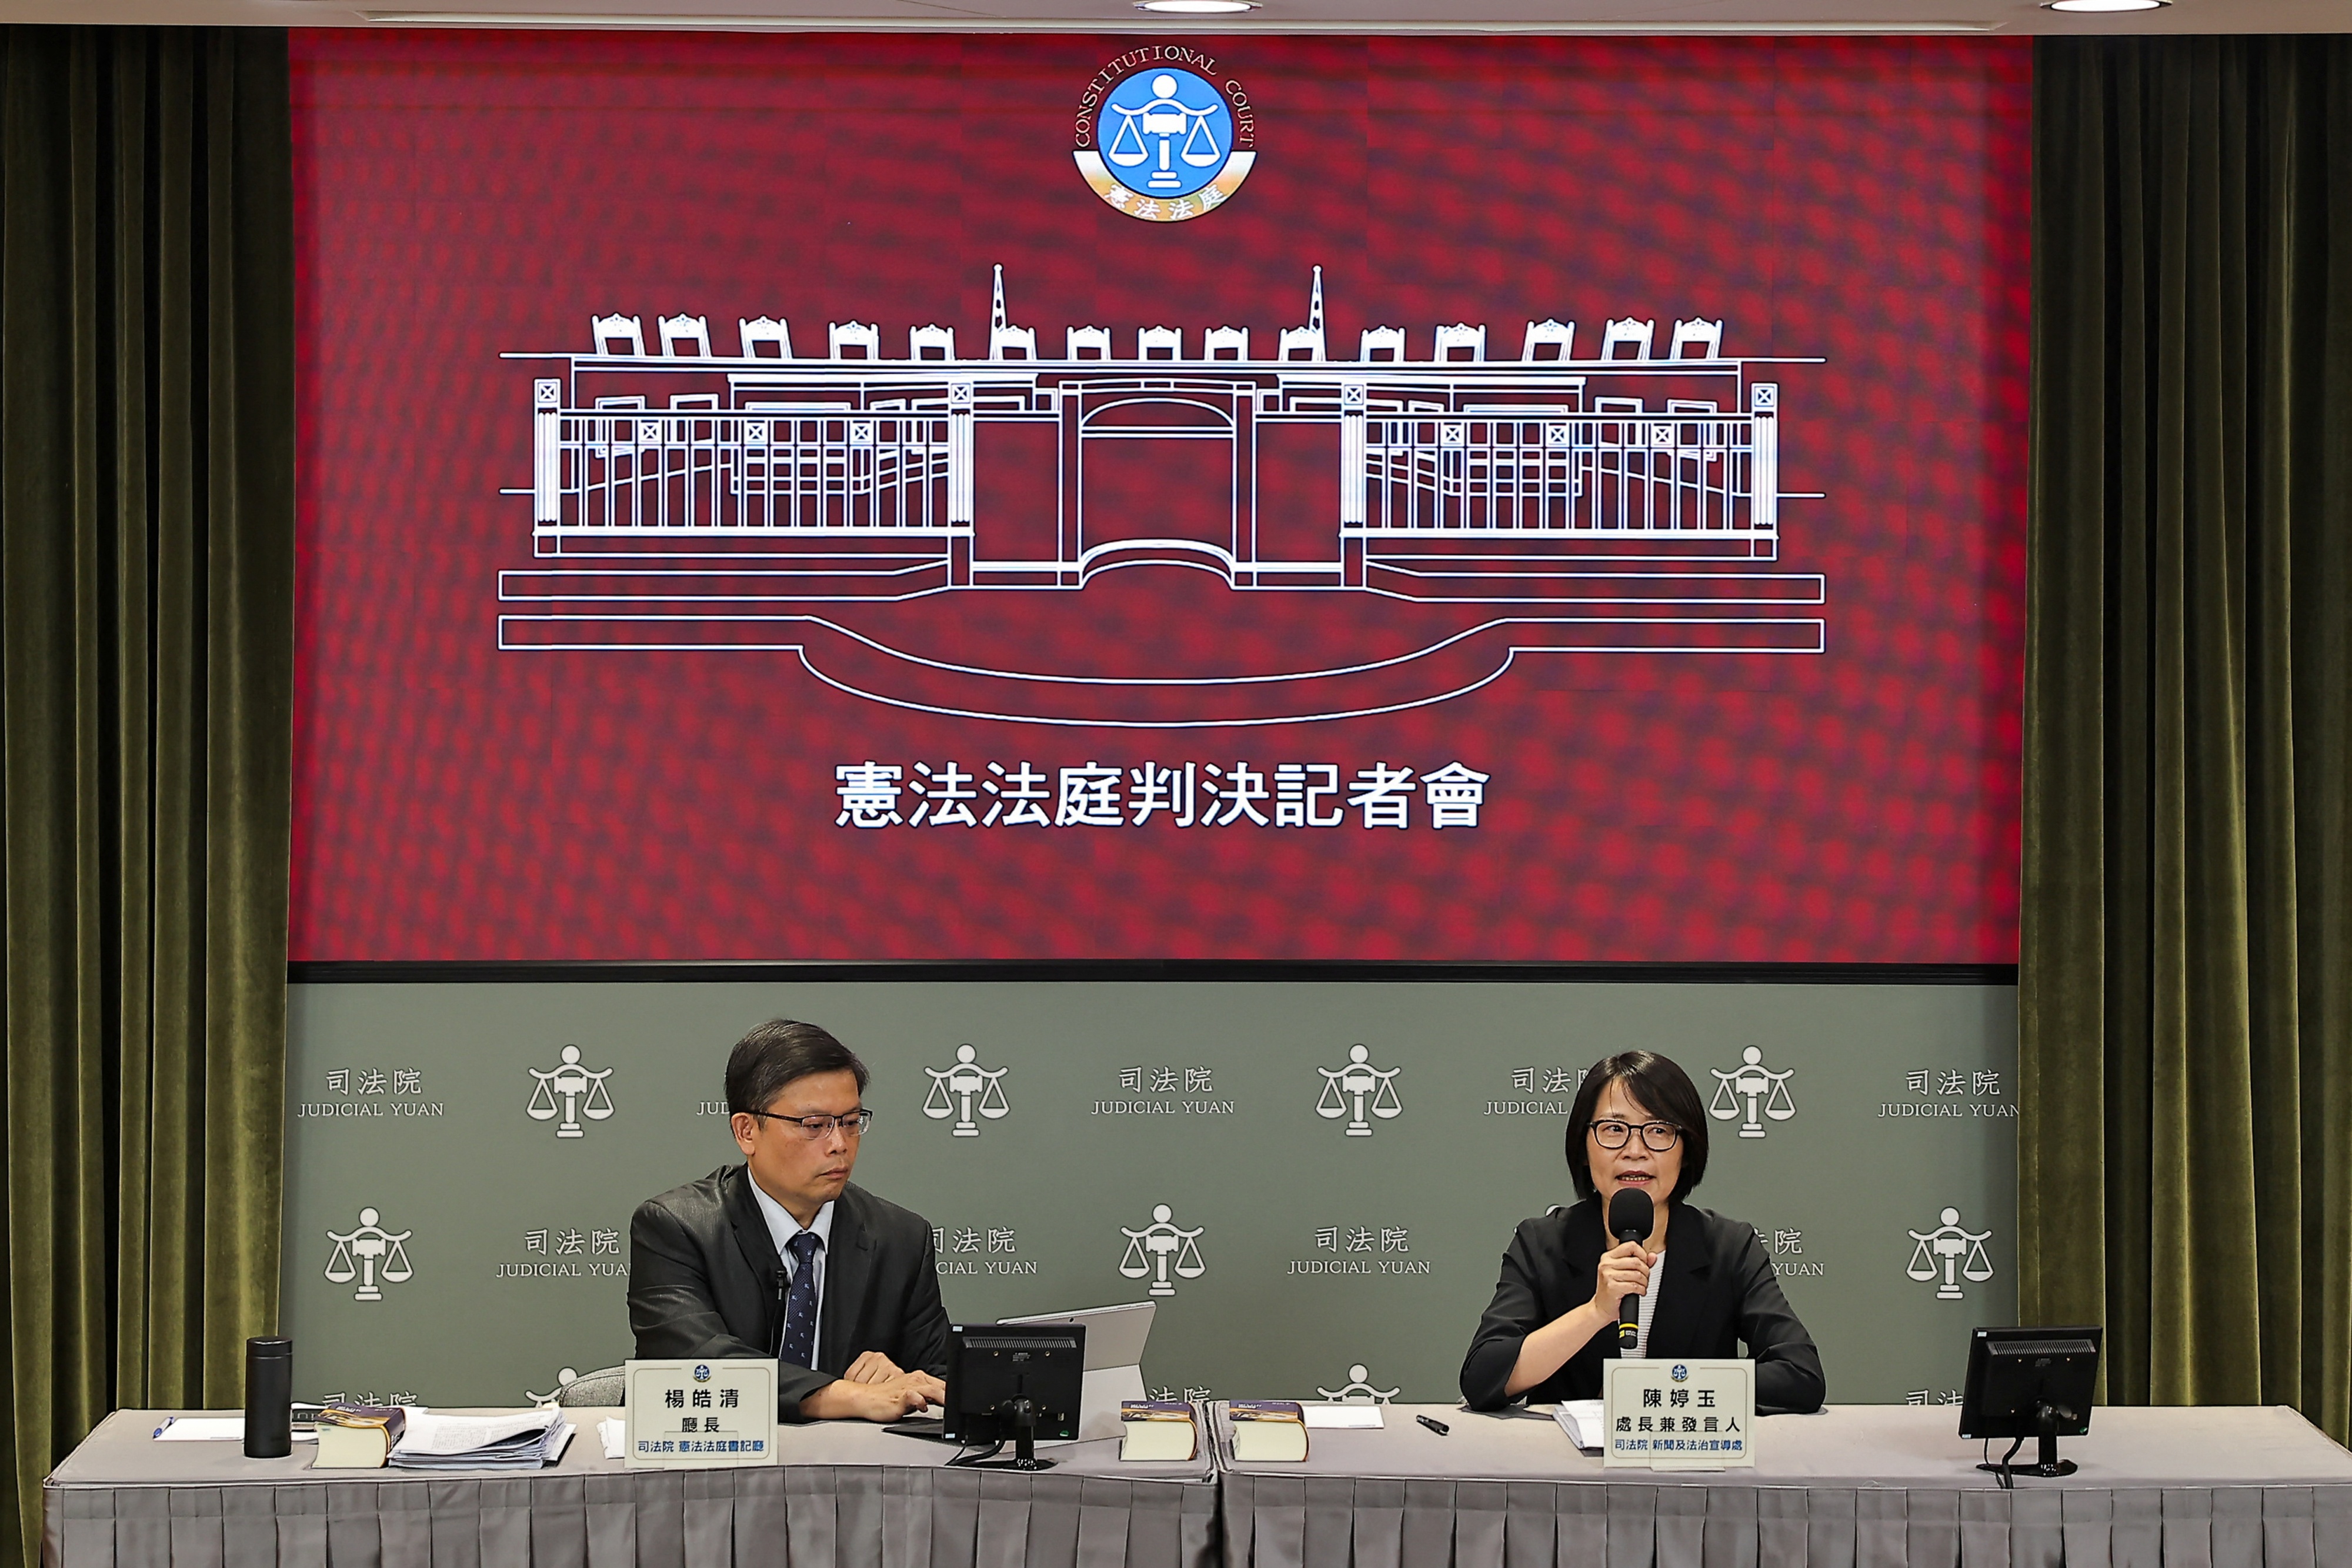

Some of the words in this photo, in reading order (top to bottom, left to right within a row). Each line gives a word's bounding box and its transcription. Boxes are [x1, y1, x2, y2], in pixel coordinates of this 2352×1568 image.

[1076, 45, 1217, 147] CONSTITUTIONAL
[1225, 80, 1255, 148] COURT
[1104, 184, 1229, 220] 憲法法庭
[835, 760, 1490, 828] 憲法法庭判決記者會
[325, 1067, 422, 1095] 司法院
[1118, 1066, 1213, 1093] 司法院
[1905, 1069, 2000, 1096] 司法院
[298, 1103, 384, 1117] JUDICIAL
[390, 1103, 443, 1116] YUAN
[1091, 1101, 1175, 1115] JUDICIAL
[1182, 1101, 1234, 1114] YUAN
[1483, 1102, 1568, 1115] JUDICIAL
[1878, 1103, 1963, 1117] JUDICIAL
[524, 1228, 620, 1255] 司法院
[1315, 1226, 1409, 1253] 司法院
[496, 1263, 582, 1277] JUDICIAL
[589, 1263, 630, 1276] YUA
[985, 1261, 1037, 1274] YUAN
[1287, 1261, 1371, 1274] JUDICIAL
[1378, 1261, 1430, 1274] YUAN
[1771, 1263, 1824, 1276] YUAN
[665, 1389, 739, 1408] 楊皓清
[1643, 1389, 1716, 1408] 陳婷玉
[682, 1417, 720, 1433] 廳長
[1616, 1416, 1741, 1433] 處長兼發言人
[638, 1440, 675, 1453] 司法院
[1615, 1439, 1649, 1451] 司法院
[1653, 1439, 1743, 1451] 新聞及法治宣導處
